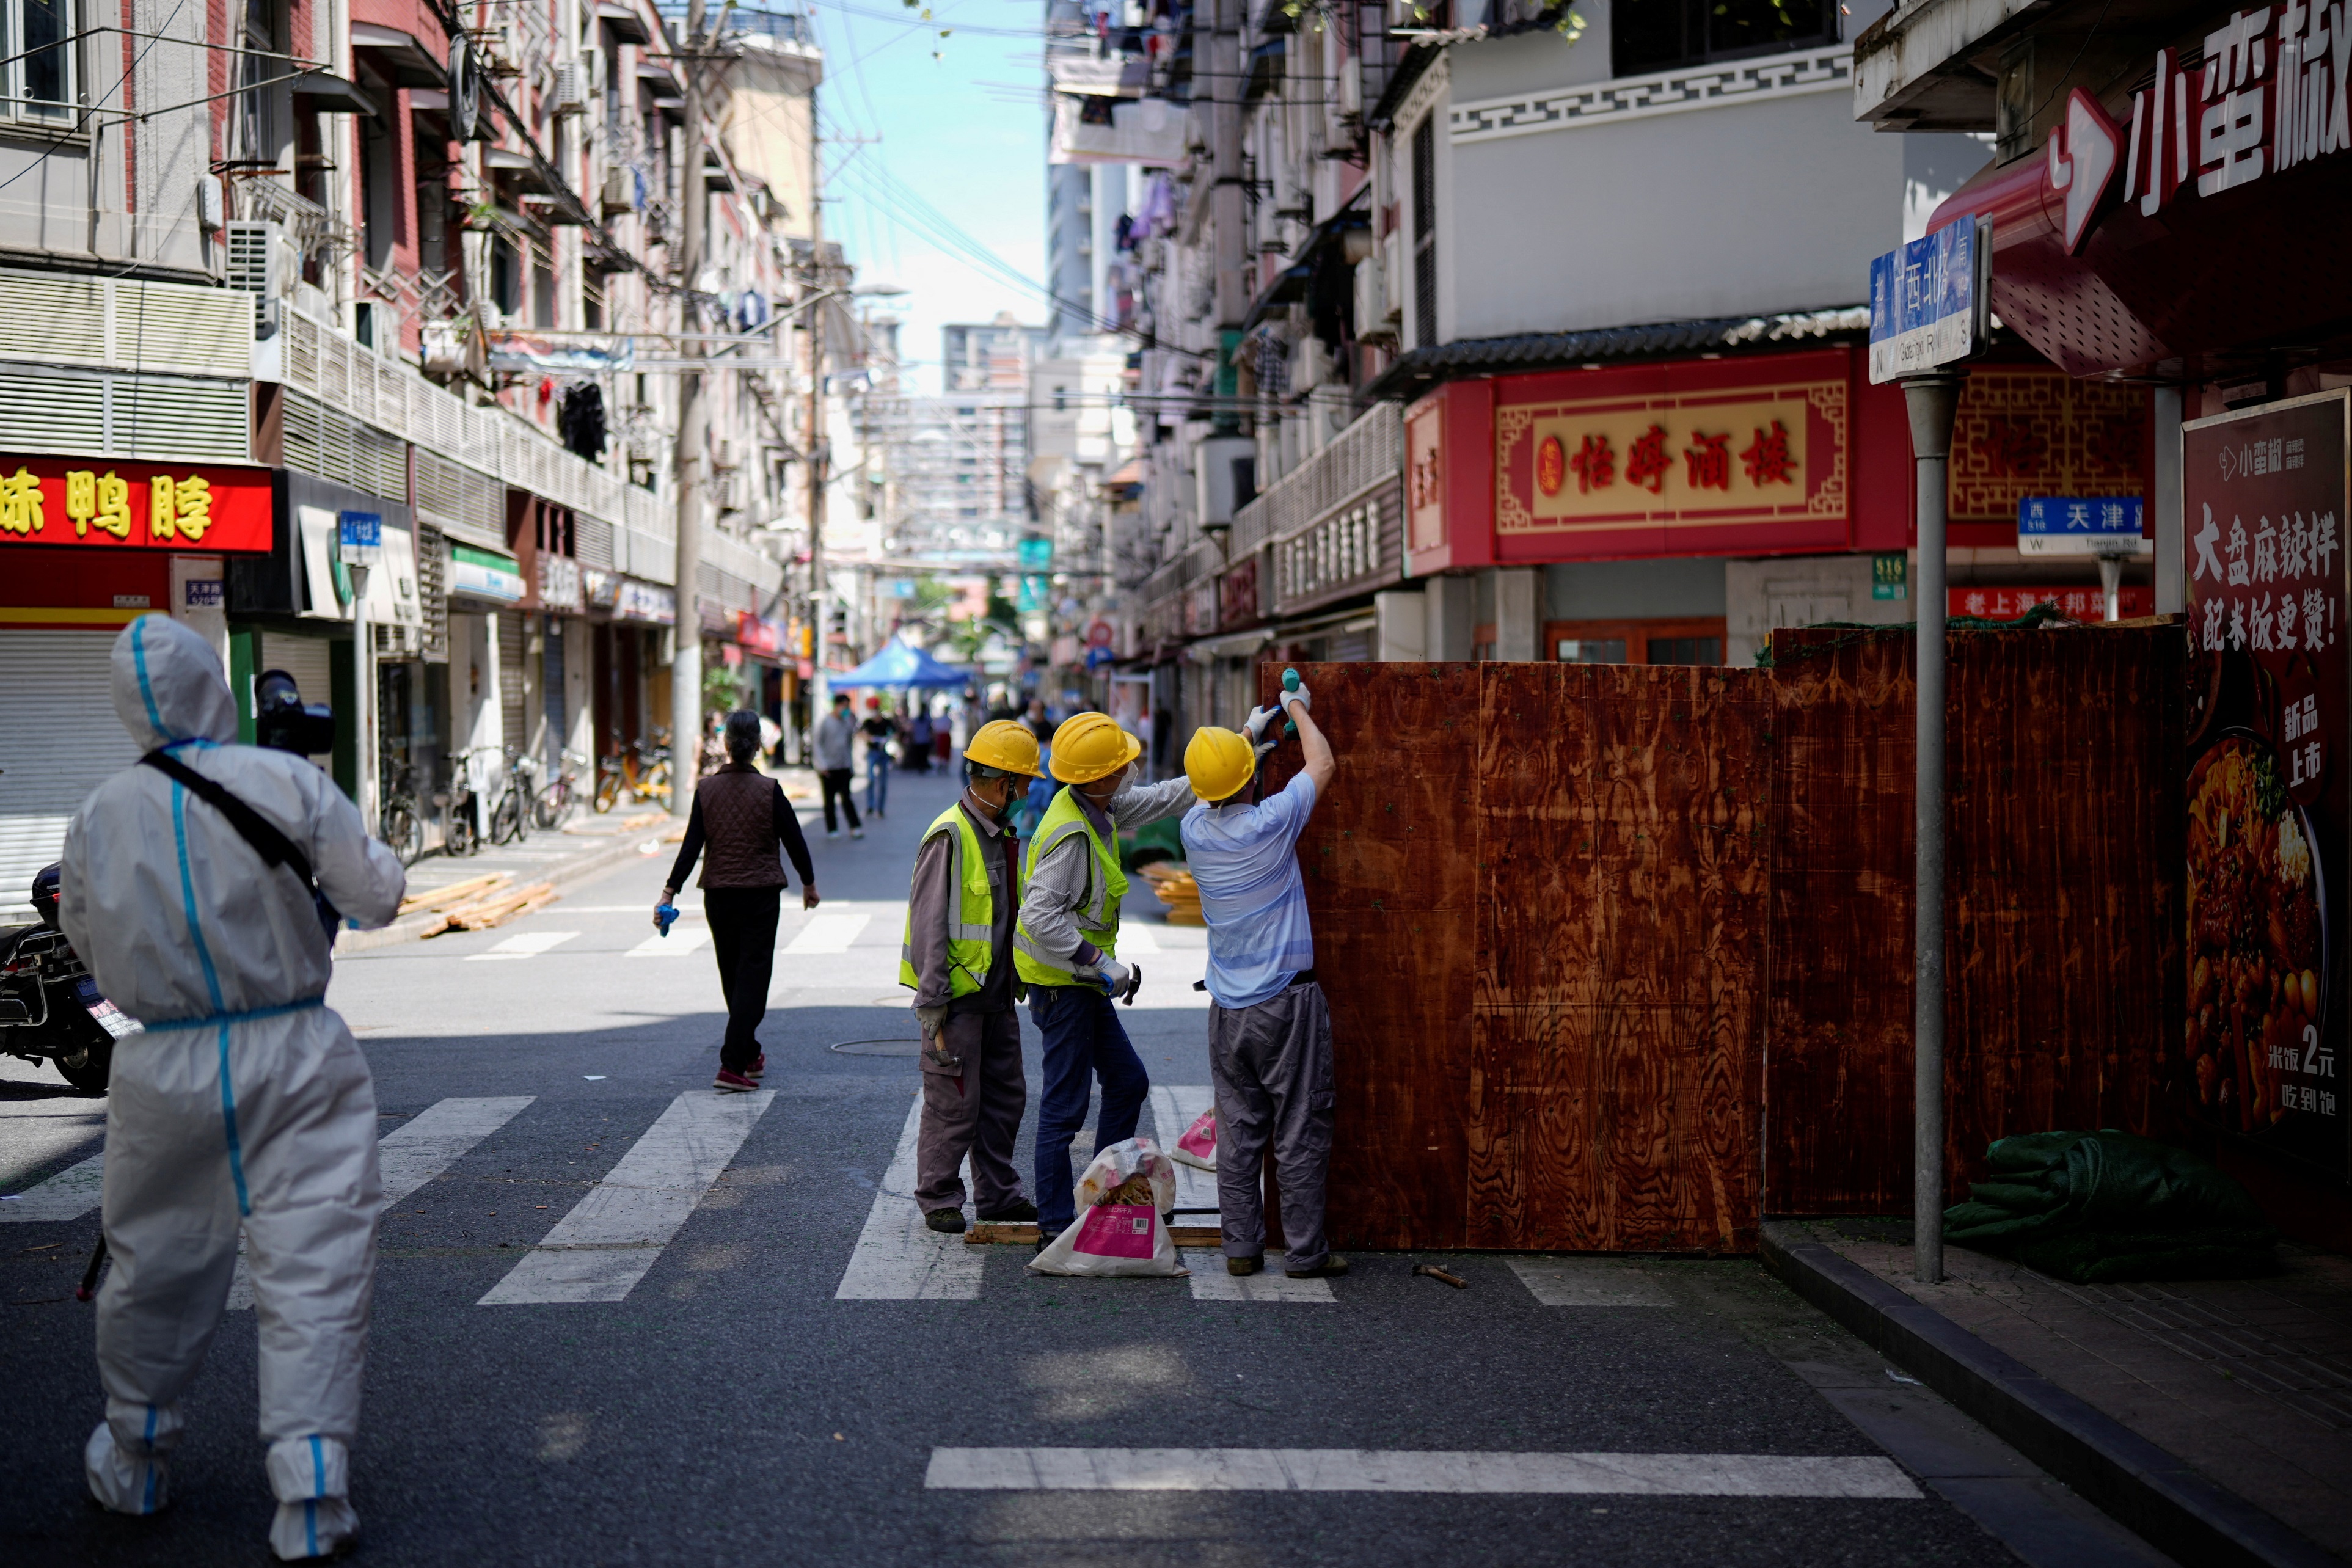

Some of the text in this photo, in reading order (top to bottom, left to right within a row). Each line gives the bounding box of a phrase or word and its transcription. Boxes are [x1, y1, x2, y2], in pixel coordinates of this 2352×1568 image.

[2124, 0, 2352, 217] 小蛮椒
[1959, 233, 1967, 269] 南
[1875, 272, 1884, 302] 北
[1960, 319, 1967, 345] S
[1876, 350, 1883, 374] N
[2238, 437, 2282, 478] 小蛮椒
[2029, 501, 2045, 519] 西
[2029, 538, 2043, 550] W
[2086, 538, 2118, 550] Tianjin
[2192, 501, 2339, 588] 大盘麻辣拌
[1875, 556, 1903, 575] 516
[190, 583, 221, 594] 天津路
[2284, 693, 2318, 743] 新品
[2290, 740, 2321, 788] 上市
[2282, 1084, 2336, 1117] 吃到饱
